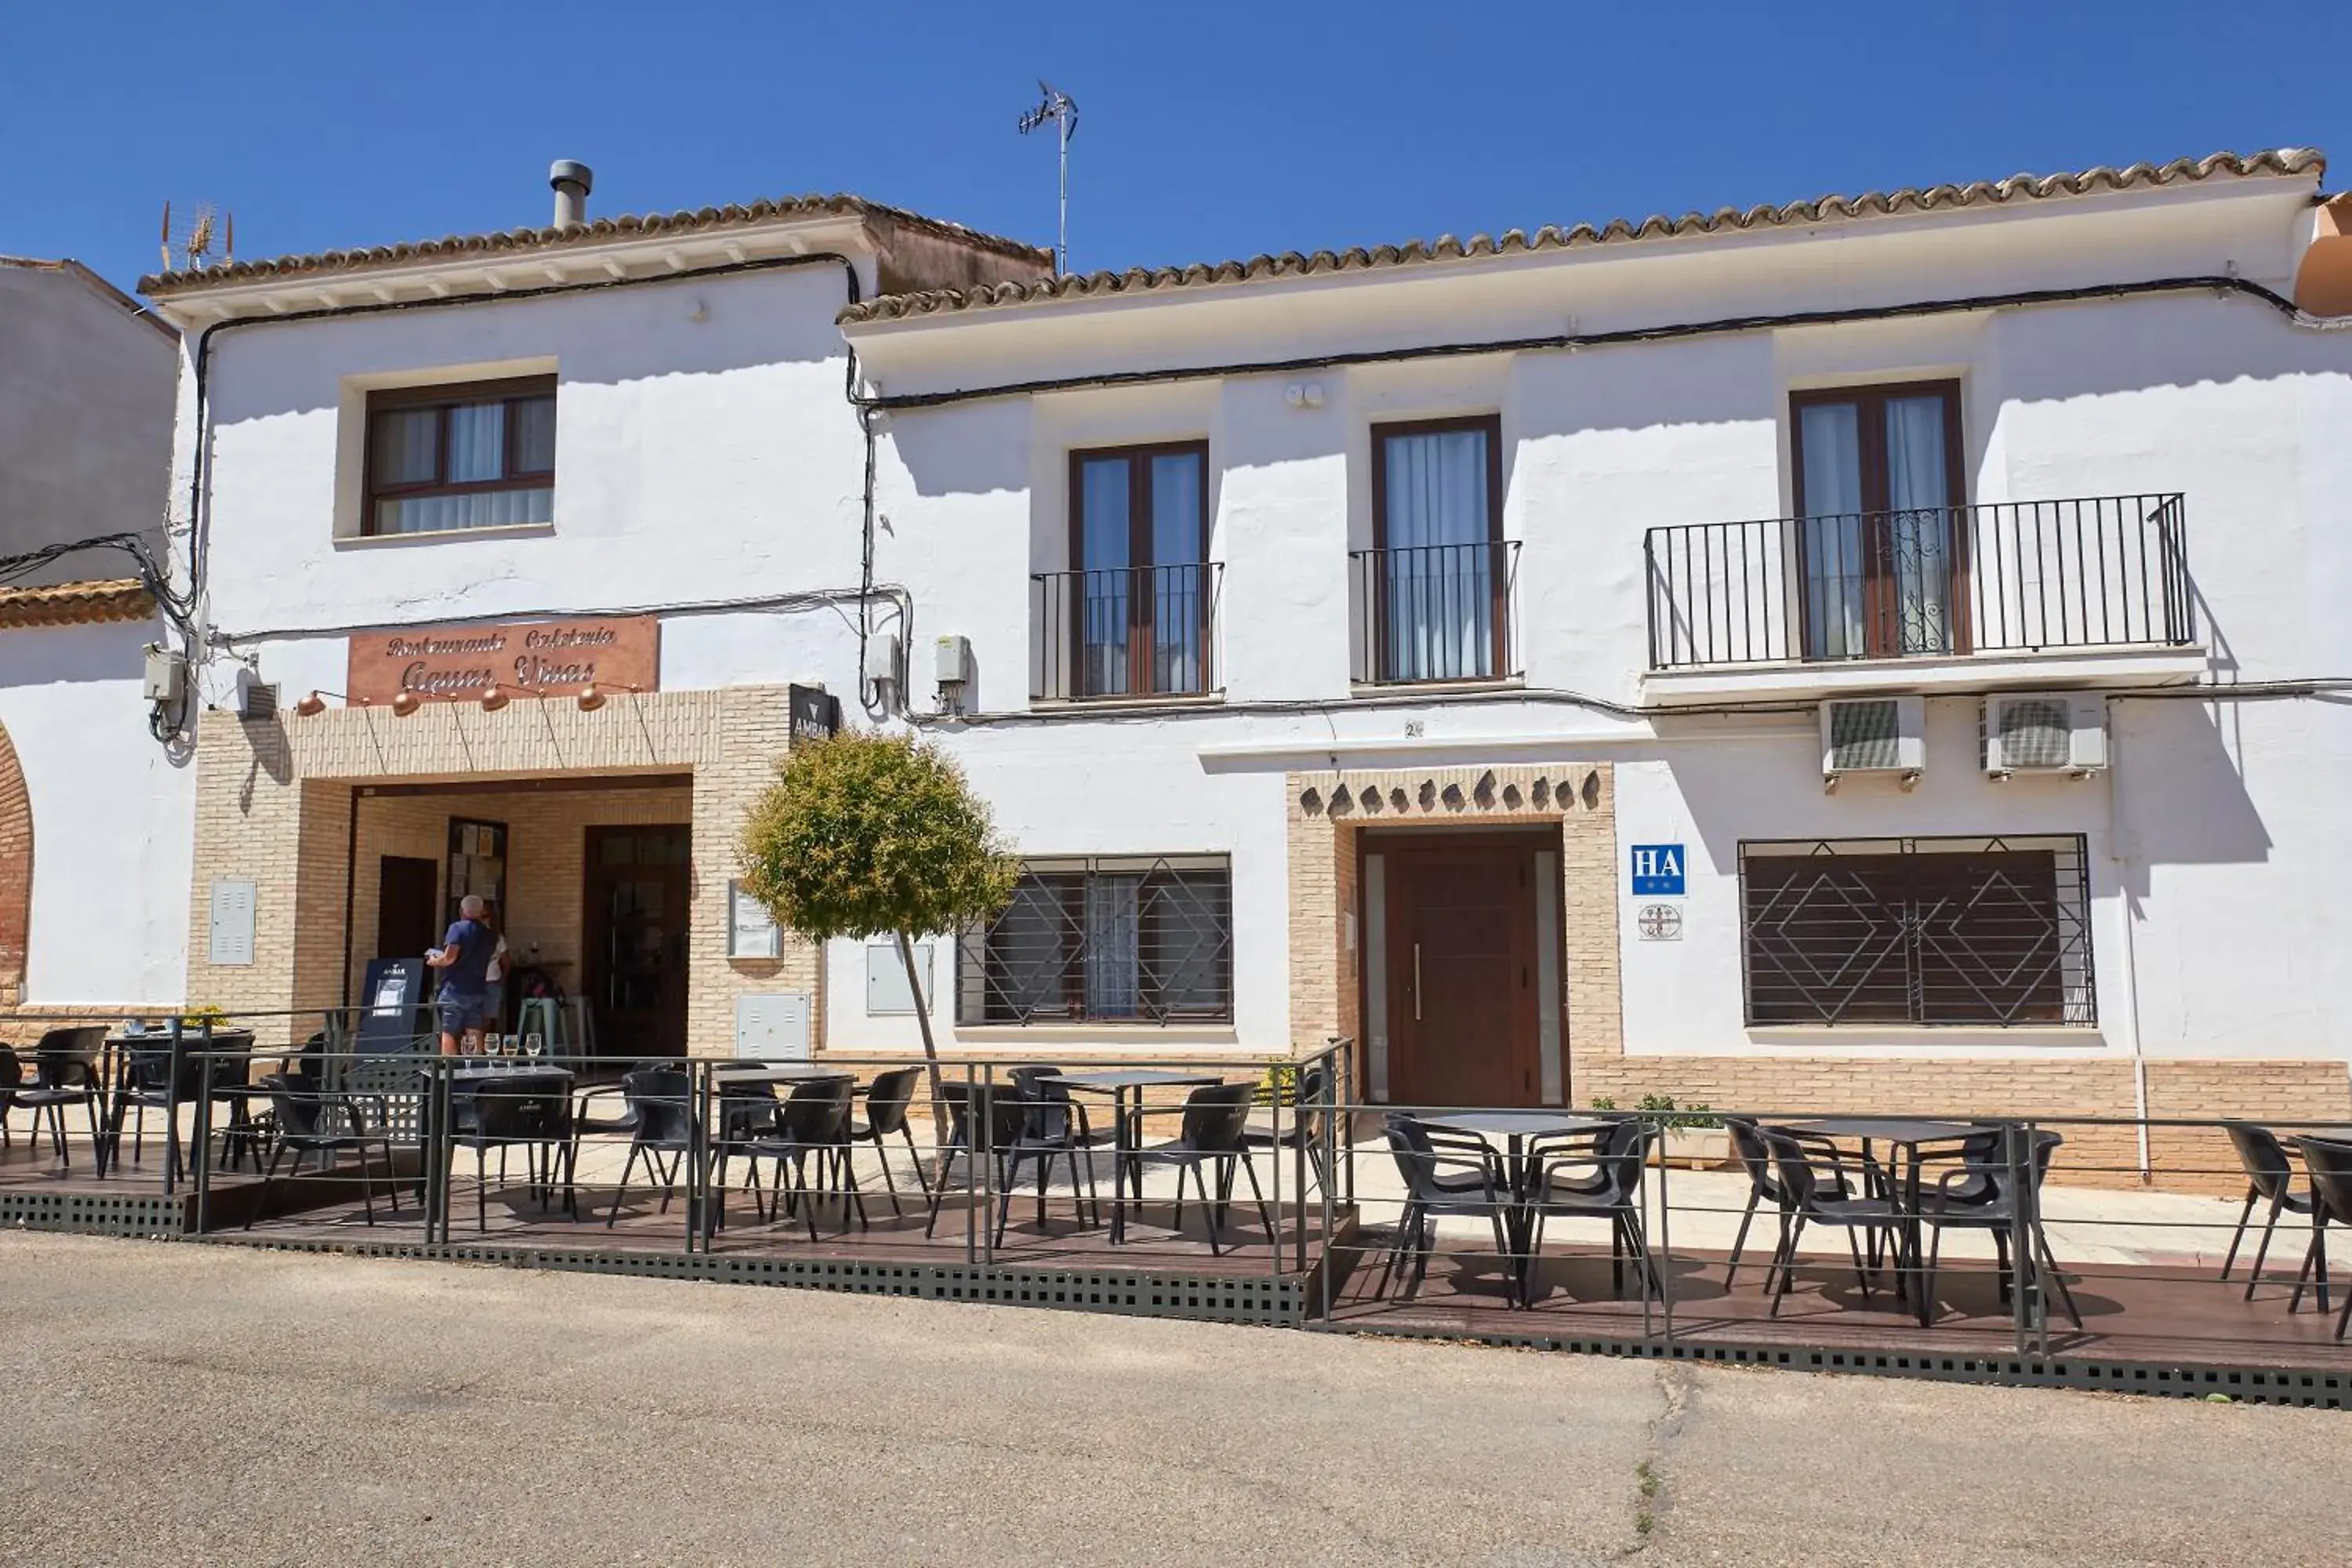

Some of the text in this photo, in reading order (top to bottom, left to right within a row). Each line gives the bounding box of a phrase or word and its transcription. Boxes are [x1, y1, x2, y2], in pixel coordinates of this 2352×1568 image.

[387, 633, 506, 657] Restaurante
[514, 655, 595, 686] Vivas
[1633, 849, 1682, 877] HA
